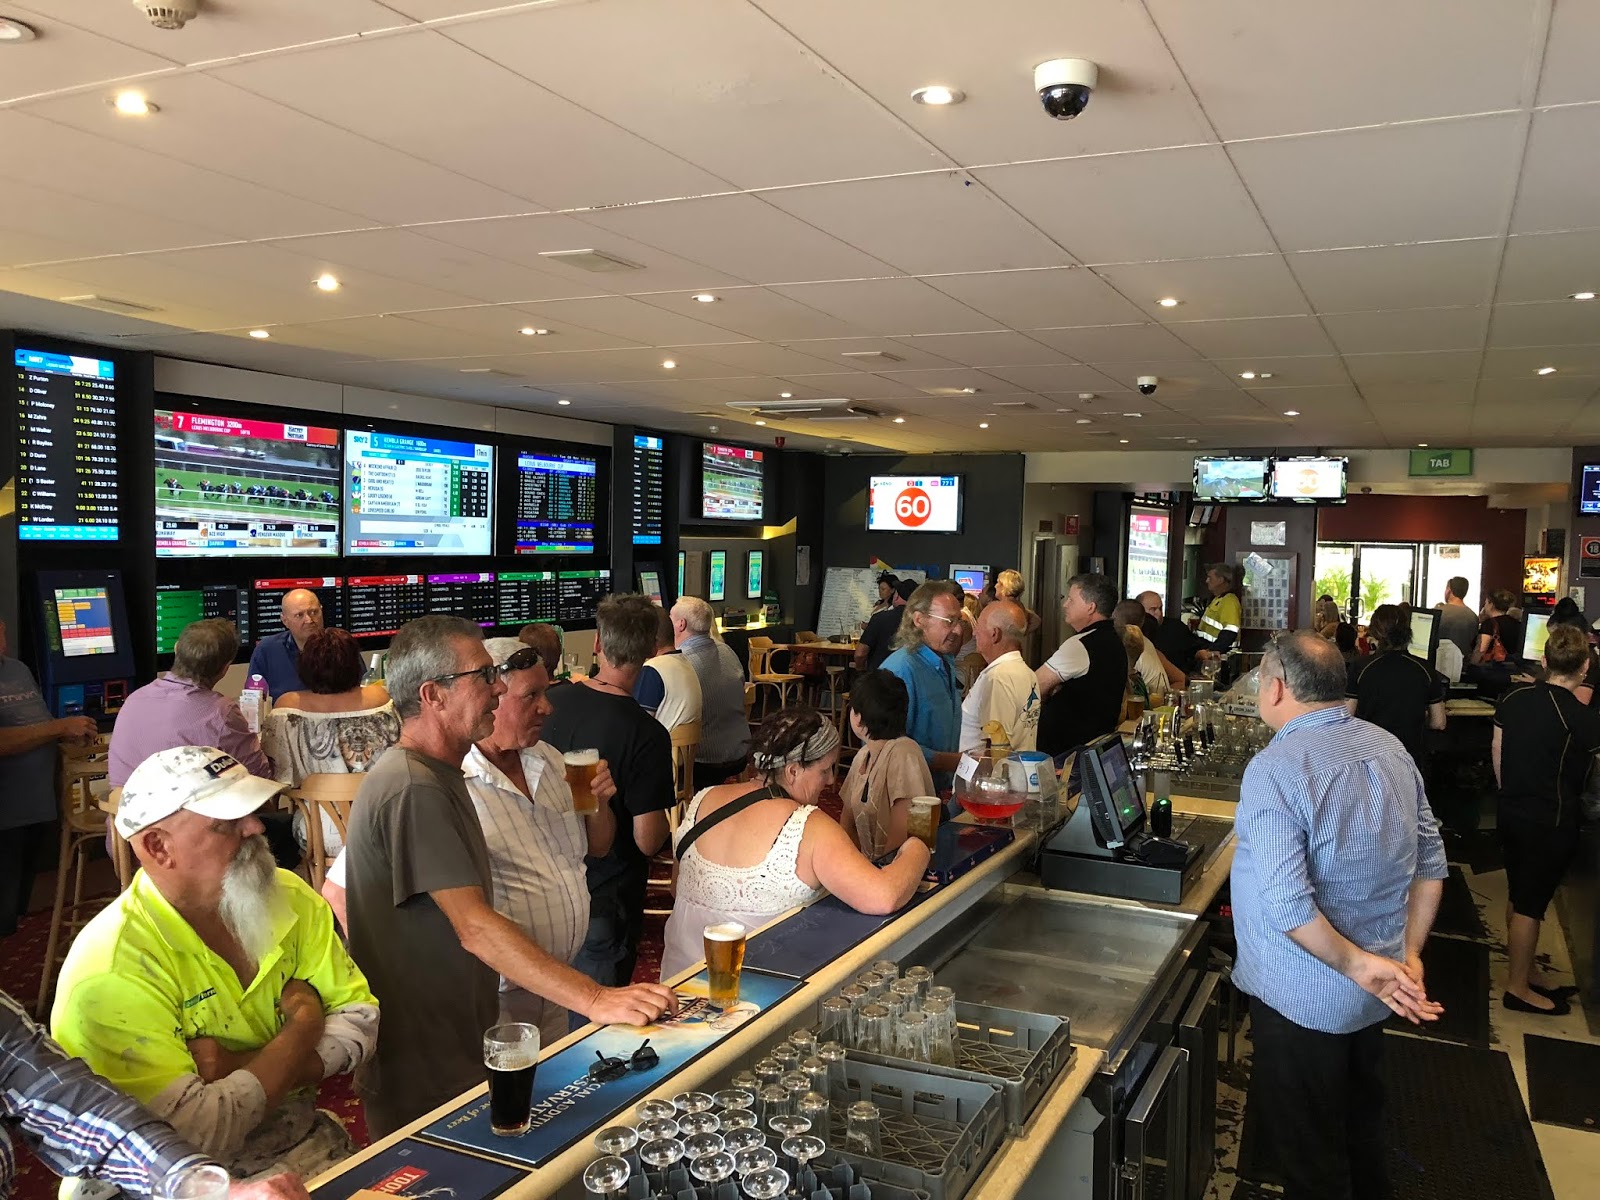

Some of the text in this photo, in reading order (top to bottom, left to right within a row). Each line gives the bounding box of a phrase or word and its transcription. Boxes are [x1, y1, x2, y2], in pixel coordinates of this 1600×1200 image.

[176, 415, 184, 429] 7
[191, 416, 243, 429] FLEMINGTON 3200m
[353, 436, 364, 444] SKY
[373, 437, 379, 447] 5
[1430, 458, 1450, 467] TAB
[896, 495, 930, 518] 60
[1589, 545, 1599, 553] 18
[374, 1171, 420, 1194] TOOH
